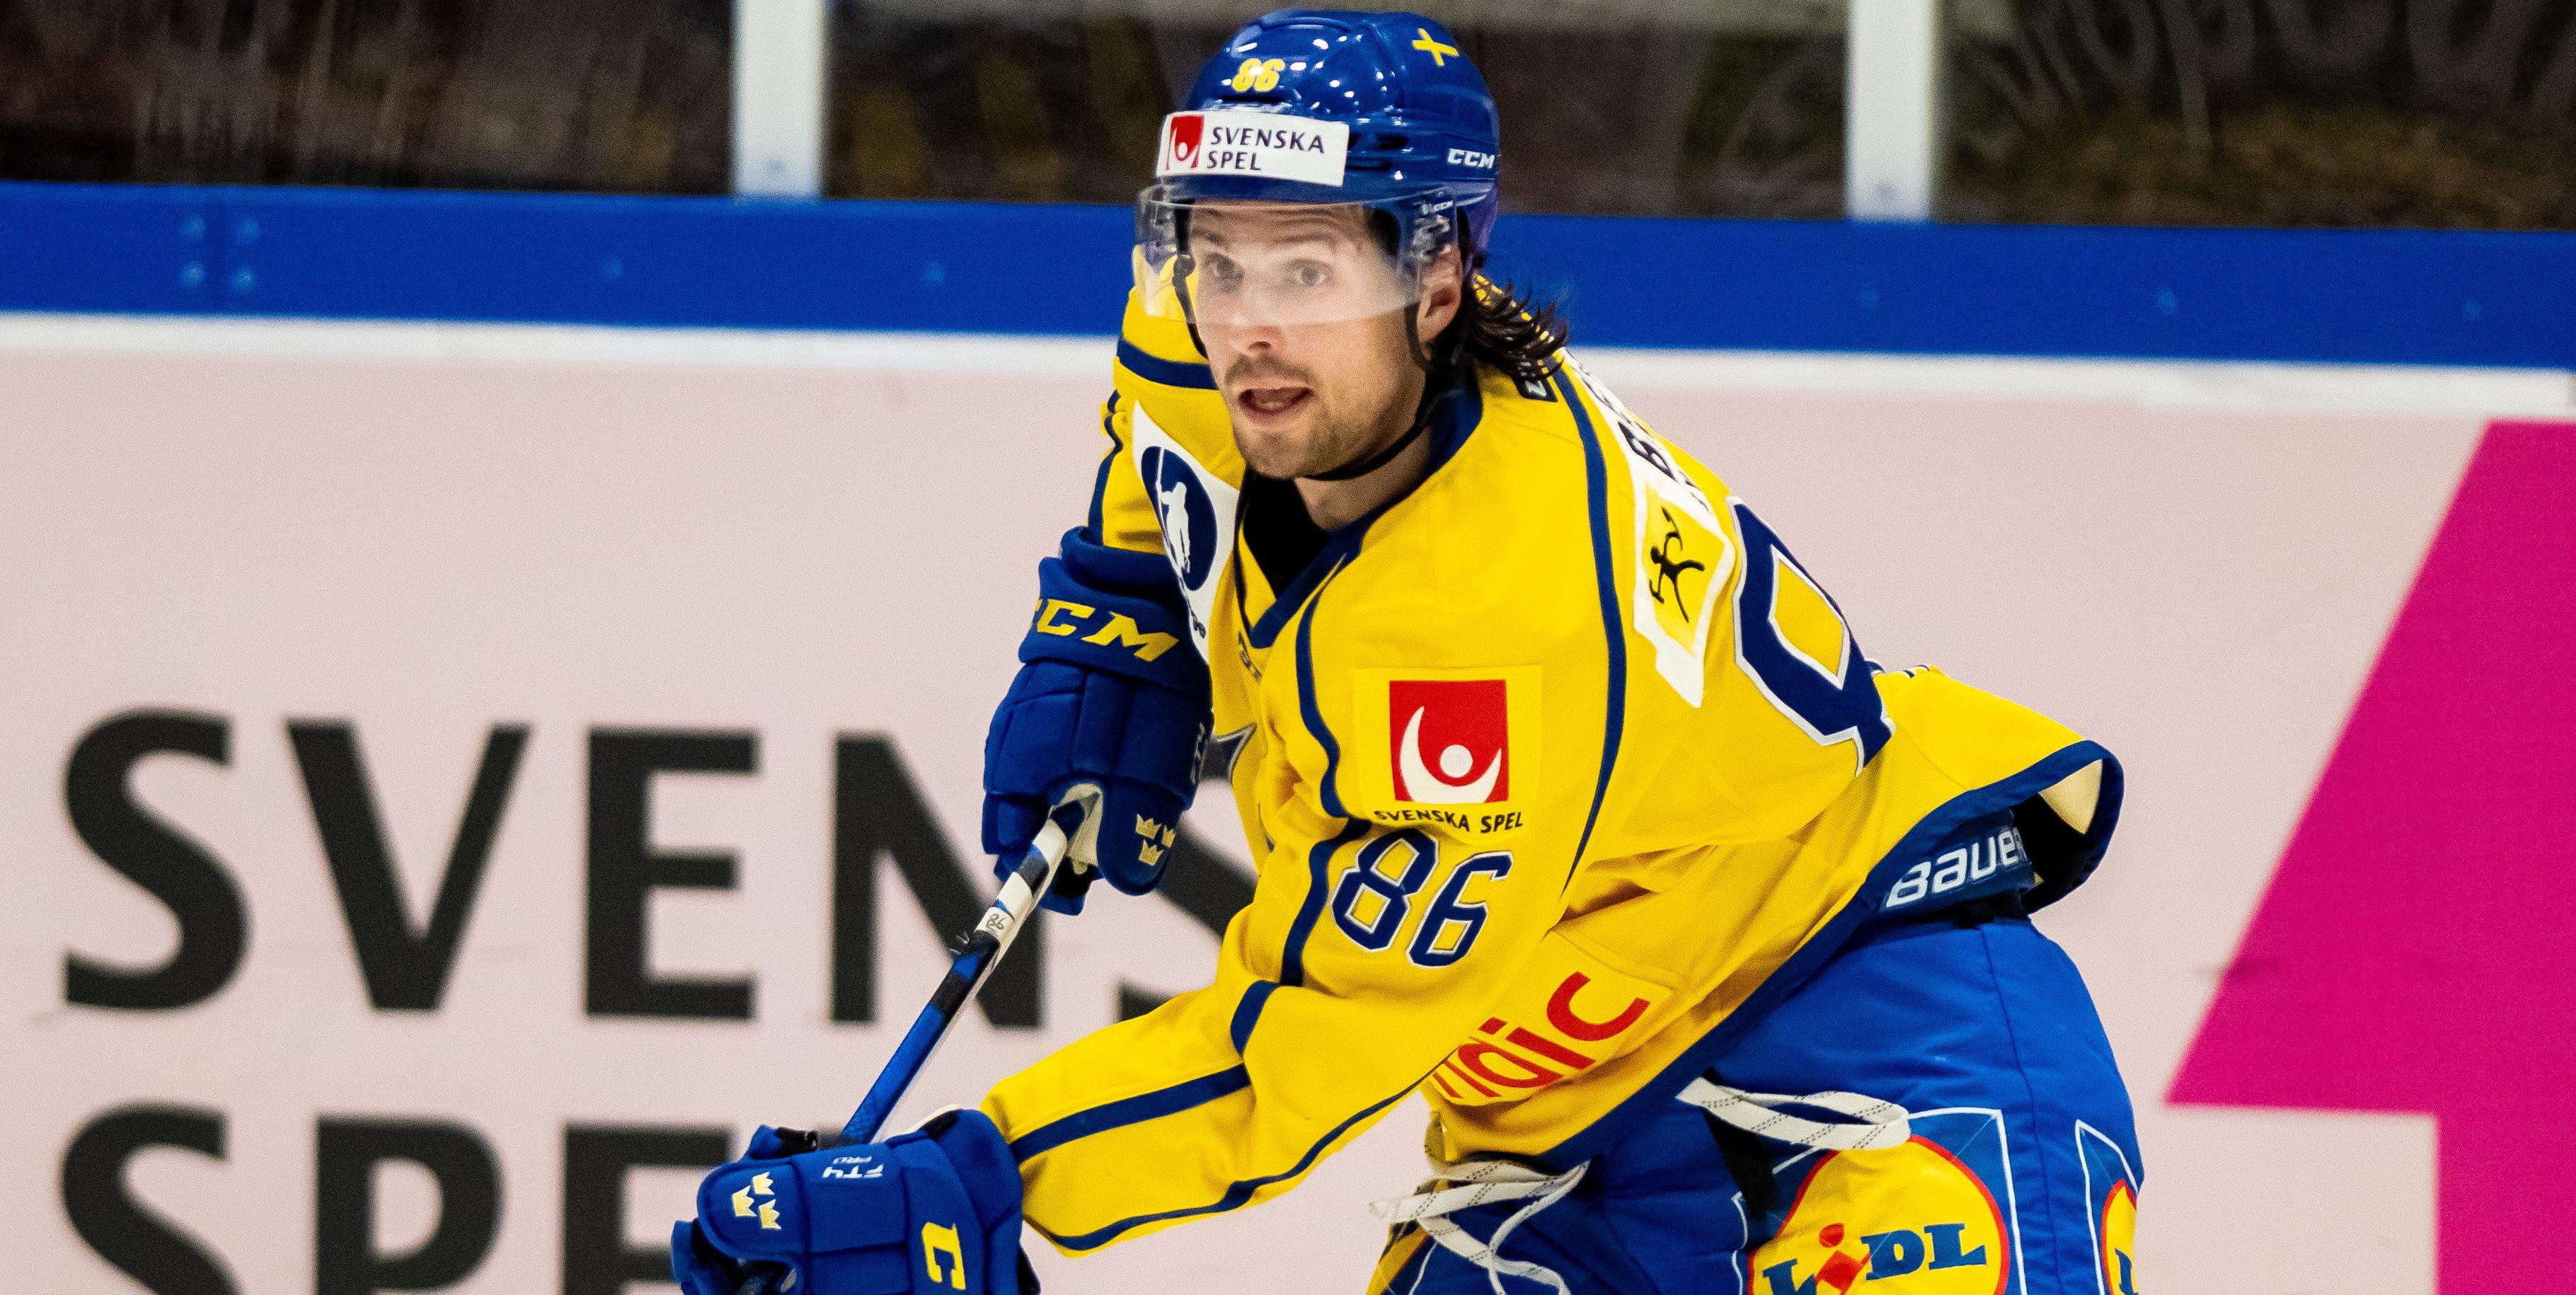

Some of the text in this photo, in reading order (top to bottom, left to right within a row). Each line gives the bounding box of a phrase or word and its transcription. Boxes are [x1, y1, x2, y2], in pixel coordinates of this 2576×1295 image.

[1232, 57, 1285, 92] 86
[1210, 126, 1325, 154] SVENSKA
[1207, 150, 1262, 171] SPEL
[1447, 148, 1495, 169] CCM
[1035, 598, 1180, 663] CM
[1373, 810, 1524, 834] SVENSKA SPEL
[1329, 829, 1514, 968] 86
[58, 1098, 853, 1295] SPE
